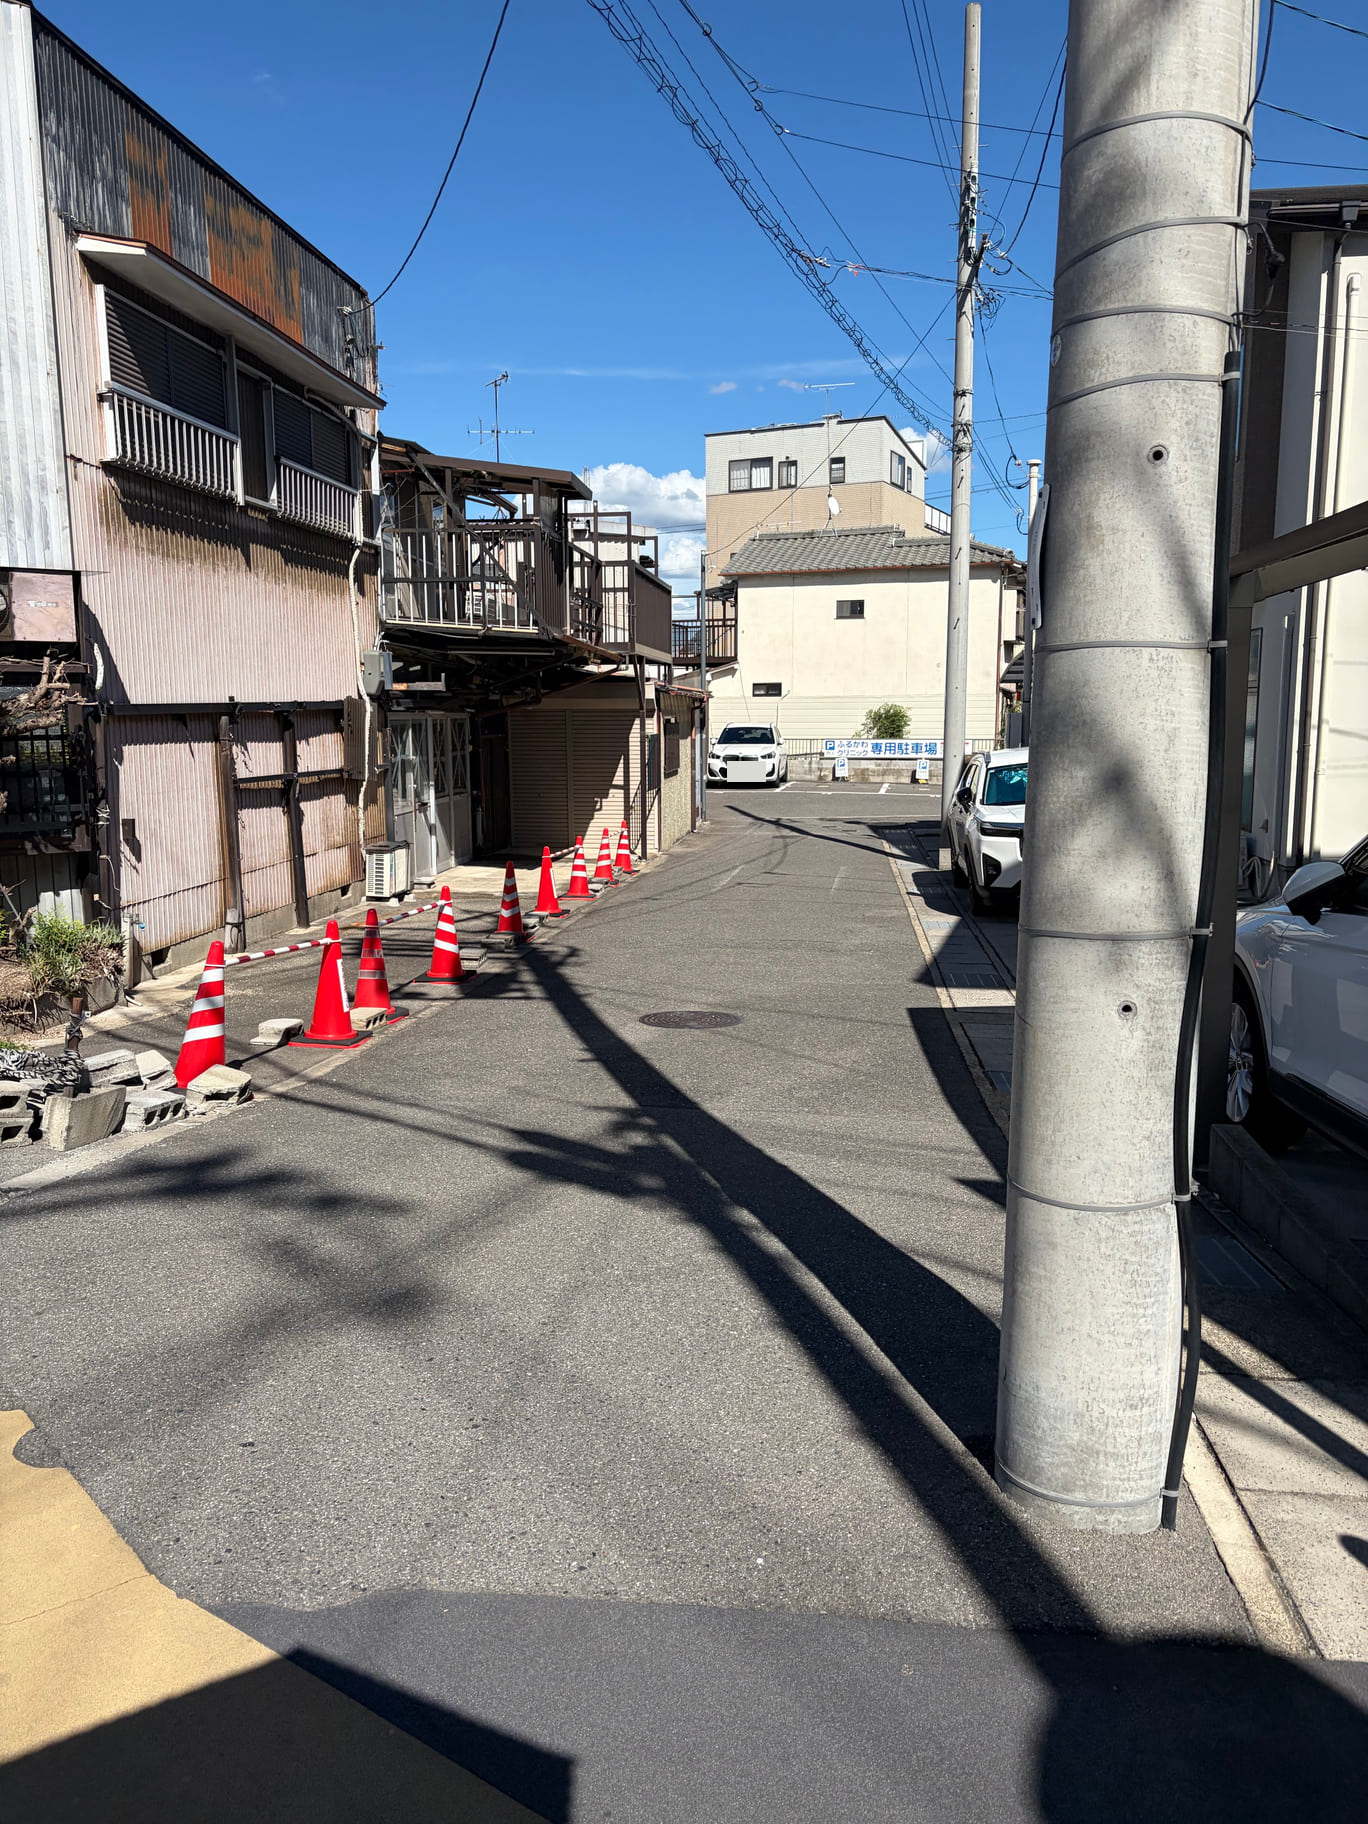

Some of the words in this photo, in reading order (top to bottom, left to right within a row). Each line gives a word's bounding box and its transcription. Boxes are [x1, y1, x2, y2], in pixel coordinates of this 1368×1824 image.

[837, 741, 868, 749] ふるかわ
[870, 742, 937, 755] 専用駐車場
[837, 749, 868, 757] クリニック
